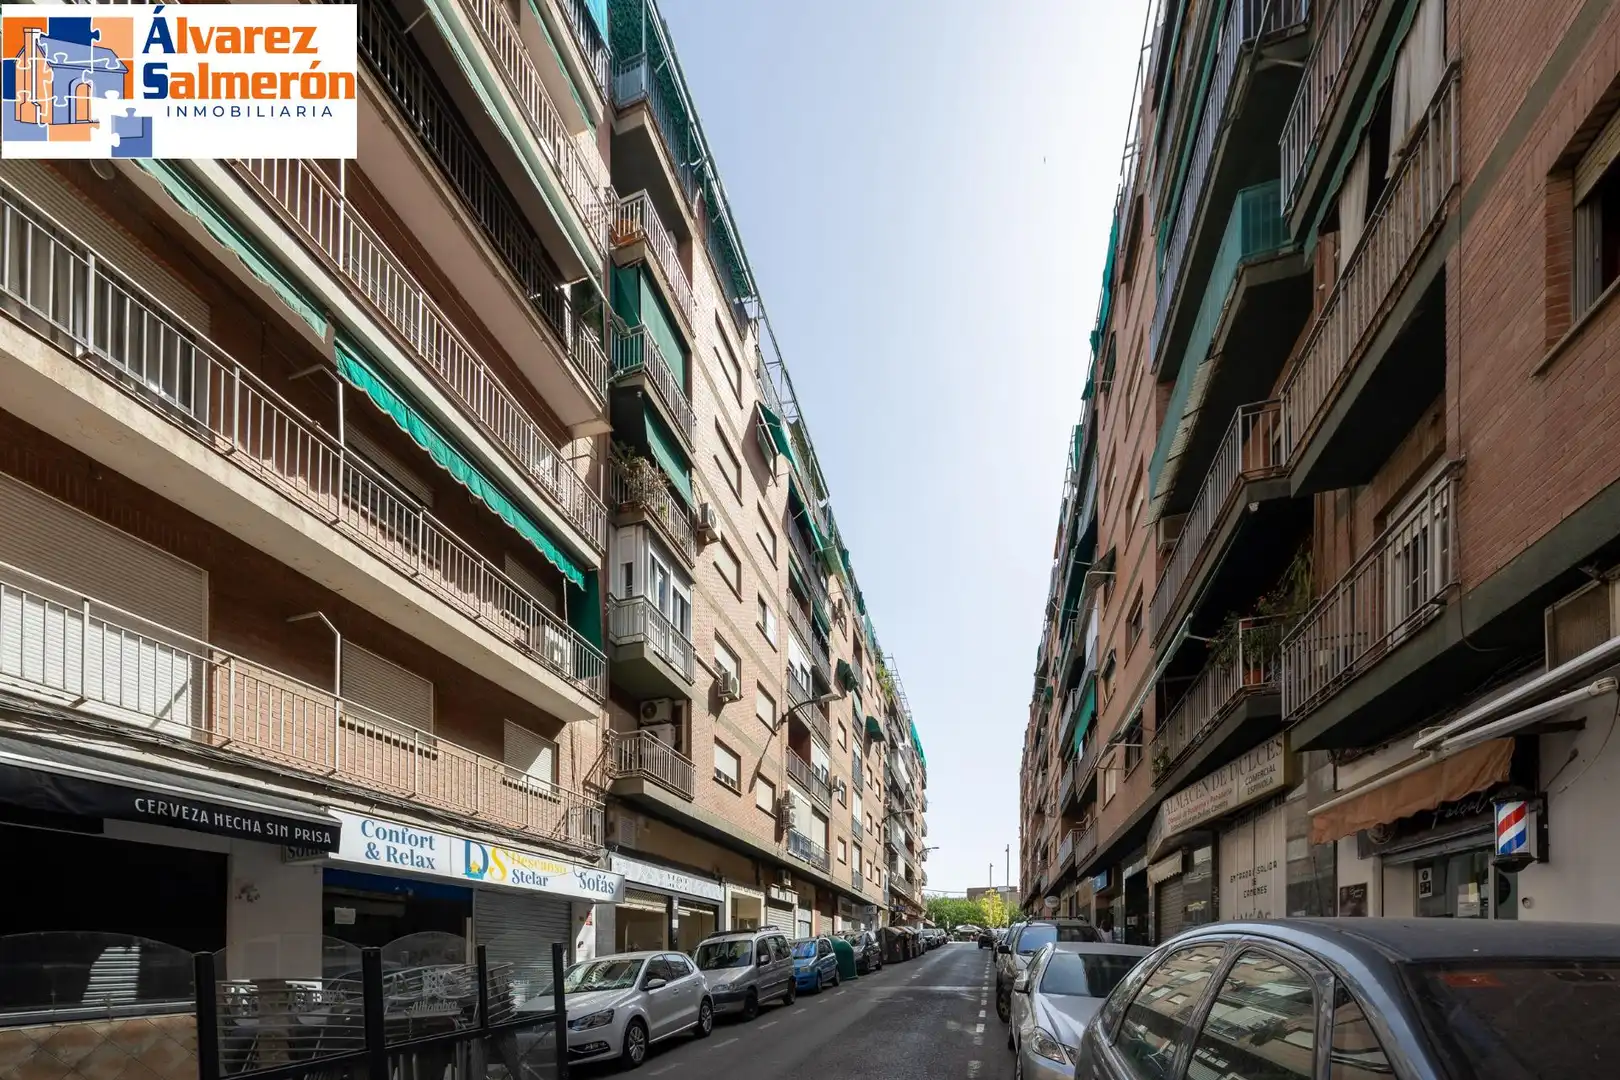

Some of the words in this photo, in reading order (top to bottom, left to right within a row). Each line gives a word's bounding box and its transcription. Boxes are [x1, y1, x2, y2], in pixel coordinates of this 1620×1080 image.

[135, 798, 209, 824] CERVEZA
[214, 813, 262, 834] HECHA
[266, 823, 289, 838] SIN
[294, 827, 332, 844] PRISA
[361, 820, 436, 851] Confort
[365, 844, 380, 861] &
[386, 844, 436, 870] Relax
[512, 869, 549, 887] Stelar
[579, 871, 614, 894] Sofás
